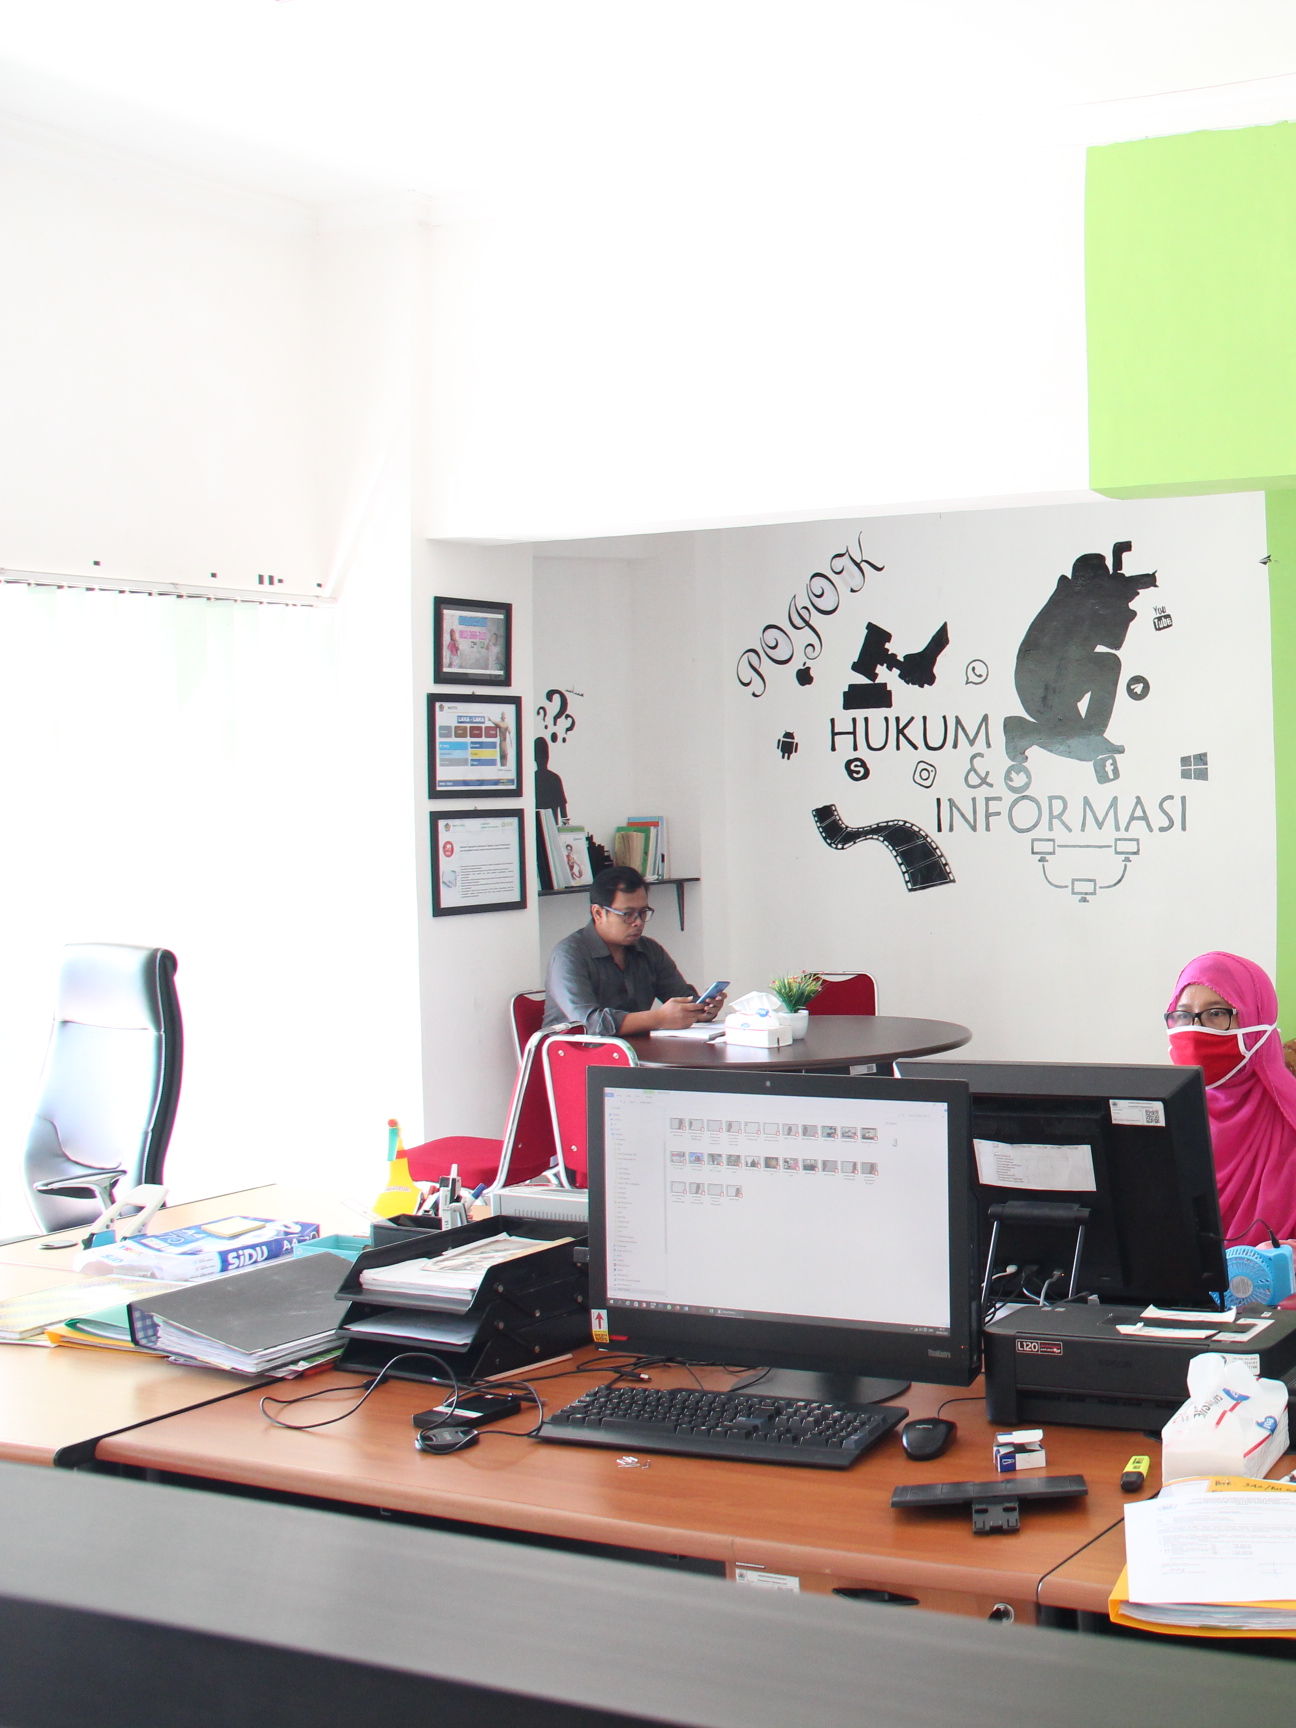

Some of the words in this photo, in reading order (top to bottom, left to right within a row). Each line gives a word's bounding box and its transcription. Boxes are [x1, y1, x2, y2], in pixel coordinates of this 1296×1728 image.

[736, 531, 885, 698] POJOK
[1154, 617, 1172, 629] Tube
[829, 713, 993, 753] HUKUM
[963, 753, 995, 790] &
[936, 794, 1188, 833] INFORMASI
[228, 1245, 268, 1270] SiDU
[1018, 1341, 1038, 1352] L120
